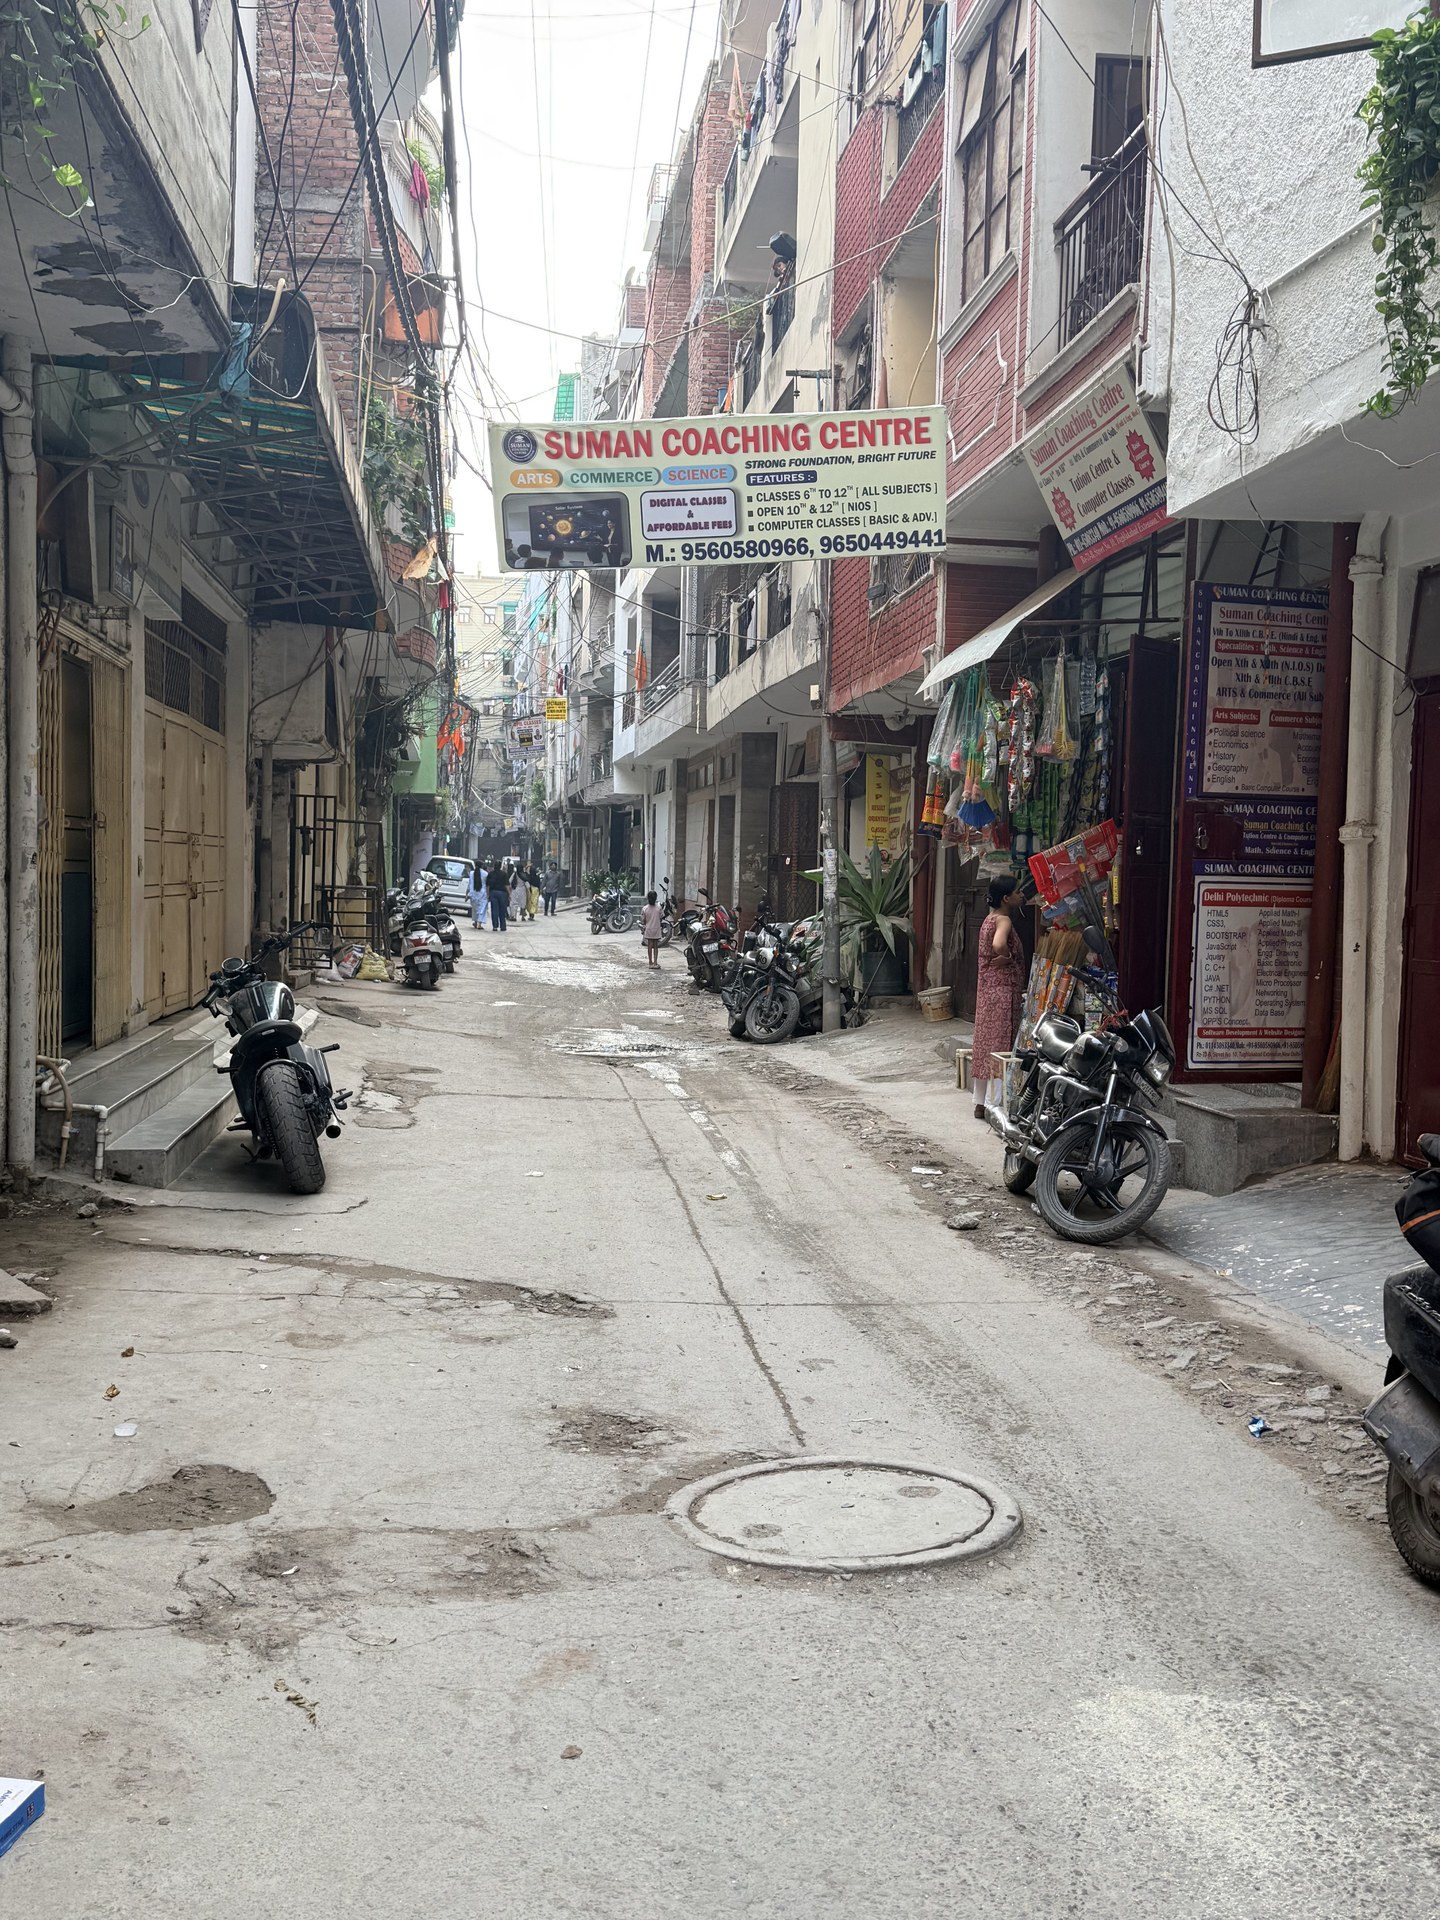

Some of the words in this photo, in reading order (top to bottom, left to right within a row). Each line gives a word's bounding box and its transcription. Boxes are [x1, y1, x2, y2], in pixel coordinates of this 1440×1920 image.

[1030, 440, 1058, 467] Suman
[1054, 408, 1097, 447] Coaching
[1092, 383, 1125, 419] Centre
[544, 430, 653, 460] SUMAN
[662, 422, 810, 456] COACHING
[820, 417, 931, 449] CENTRE
[745, 460, 786, 469] STRONG
[789, 456, 855, 467] FOUNDATION,
[858, 453, 895, 463] BRIGHT
[898, 451, 936, 461] FUTURE
[668, 467, 727, 481] SCIENCE
[1069, 470, 1092, 493] Tution
[1089, 455, 1115, 481] Centre
[1110, 447, 1120, 466] &
[517, 473, 553, 484] ARTS
[570, 471, 653, 483] COMMERCE
[750, 474, 804, 483] FEATURES
[756, 491, 801, 502] CLASSES
[819, 489, 831, 499] TO
[862, 487, 879, 497] ALL
[882, 484, 931, 495] SUBJECTS
[1077, 489, 1108, 518] Computer
[1105, 474, 1135, 500] Classes
[650, 498, 688, 507] DIGITAL
[757, 506, 784, 516] OPEN
[809, 504, 817, 513] &
[848, 501, 871, 511] NIOS
[687, 510, 694, 518] &
[647, 522, 709, 532] AFFORDABLE
[757, 520, 813, 531] COMPUTER
[816, 517, 860, 528] CLASSES
[869, 514, 899, 525] BASIC
[902, 513, 910, 522] &
[645, 544, 676, 562] M.:
[680, 537, 814, 562] 9560580966,
[820, 529, 946, 554] 9650449441
[1218, 587, 1248, 598] SUMAN
[1219, 607, 1253, 620] Suman
[1257, 609, 1302, 625] Coaching
[1225, 628, 1233, 637] To
[1279, 631, 1298, 641] (Hindi
[1300, 633, 1304, 641] &
[1306, 633, 1320, 643] Eng.
[1217, 641, 1255, 652] Specialities
[1280, 646, 1303, 654] Science
[1211, 657, 1232, 668] Open
[1235, 658, 1249, 668] Xth
[1251, 659, 1257, 668] &
[1282, 662, 1314, 674] (N.I.O.S)
[1254, 674, 1260, 683] &
[1284, 676, 1312, 687] C.B.S.E
[1216, 687, 1237, 696] ARTS
[1240, 688, 1245, 697] &
[1248, 688, 1291, 700] Commerce
[1215, 711, 1228, 719] Arts
[1230, 712, 1259, 722] Subjects:
[1271, 715, 1303, 723] Commerce
[1213, 728, 1239, 737] Political
[1241, 730, 1266, 738] science
[1213, 740, 1249, 749] Economics
[1213, 751, 1236, 761] History
[1212, 763, 1248, 773] Geography
[1211, 775, 1236, 785] English
[1256, 785, 1281, 793] Computer
[1224, 804, 1255, 814] SUMAN
[1257, 805, 1303, 815] COACHING
[1243, 820, 1268, 830] Suman
[1271, 821, 1304, 832] Coaching
[1245, 846, 1263, 855] Math,
[1265, 846, 1291, 855] Science
[1238, 864, 1284, 874] COACHING
[1204, 892, 1223, 901] Delhi
[1226, 893, 1270, 903] Polytechnic
[1259, 909, 1280, 918] Applied
[1207, 920, 1226, 928] CSS3,
[1258, 919, 1280, 928] Applied
[1206, 932, 1247, 940] BOOTSTRAP
[1258, 929, 1280, 937] Applied
[1206, 943, 1237, 951] JavaScript
[1258, 940, 1280, 948] Applied
[1282, 940, 1303, 948] Physics
[1206, 953, 1225, 961] Jquery
[1276, 950, 1299, 958] Drawing
[1257, 959, 1273, 967] Basic
[1256, 989, 1288, 998] Networking
[1203, 996, 1231, 1004] PYTHON
[1255, 999, 1284, 1008] Operating
[1203, 1007, 1213, 1015] MS
[1214, 1007, 1227, 1015] SQL
[1255, 1009, 1269, 1017] Data
[1270, 1009, 1284, 1017] Base
[1226, 1029, 1258, 1037] Development
